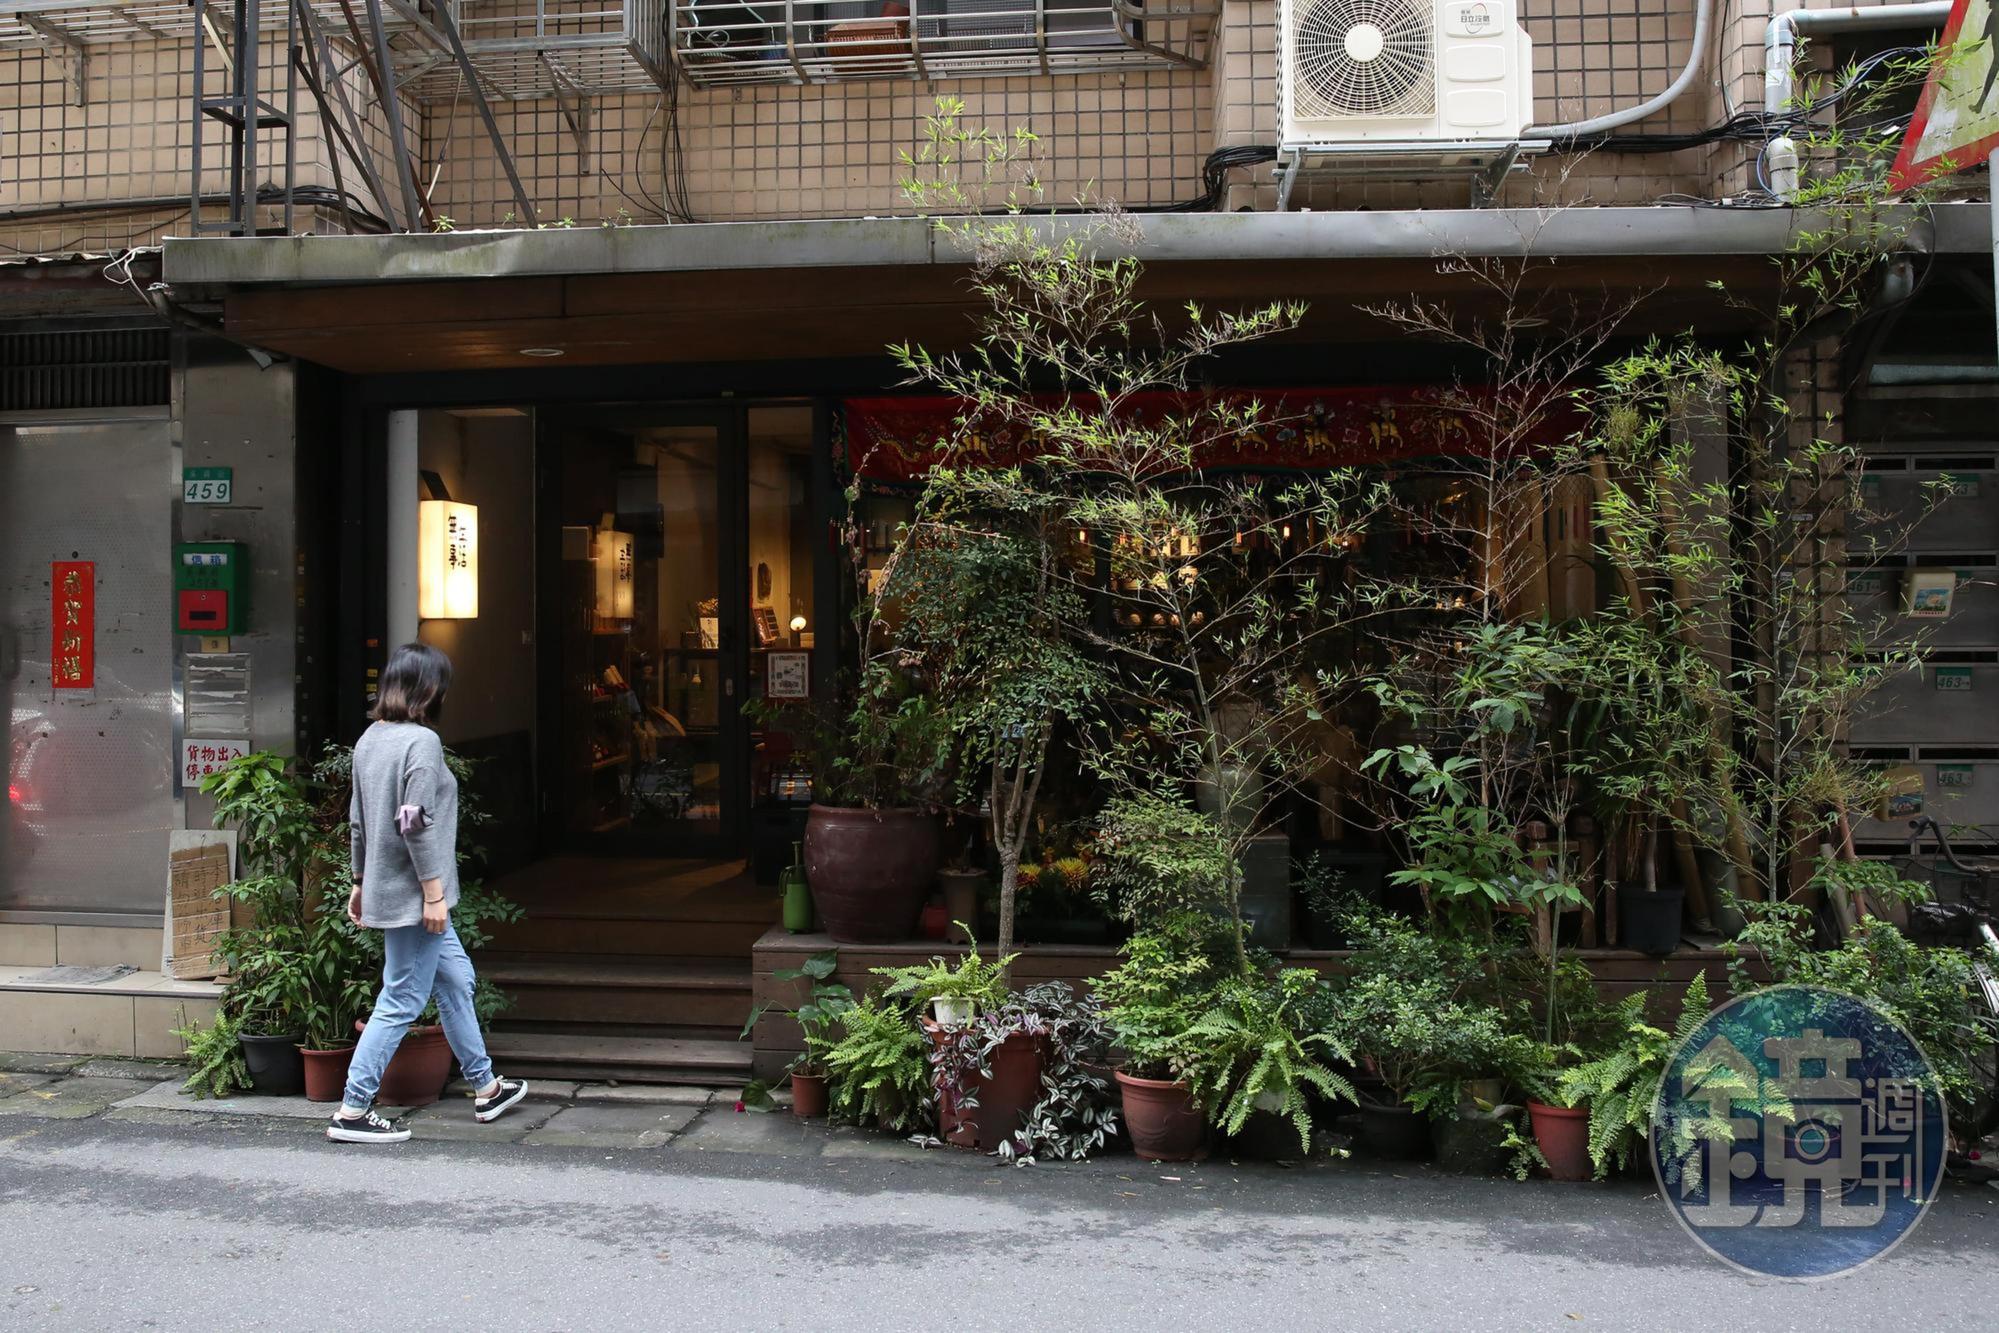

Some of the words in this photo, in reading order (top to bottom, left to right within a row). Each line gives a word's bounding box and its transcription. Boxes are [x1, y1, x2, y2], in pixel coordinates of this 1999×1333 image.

[186, 483, 228, 499] 459
[187, 745, 242, 762] 貨物出入
